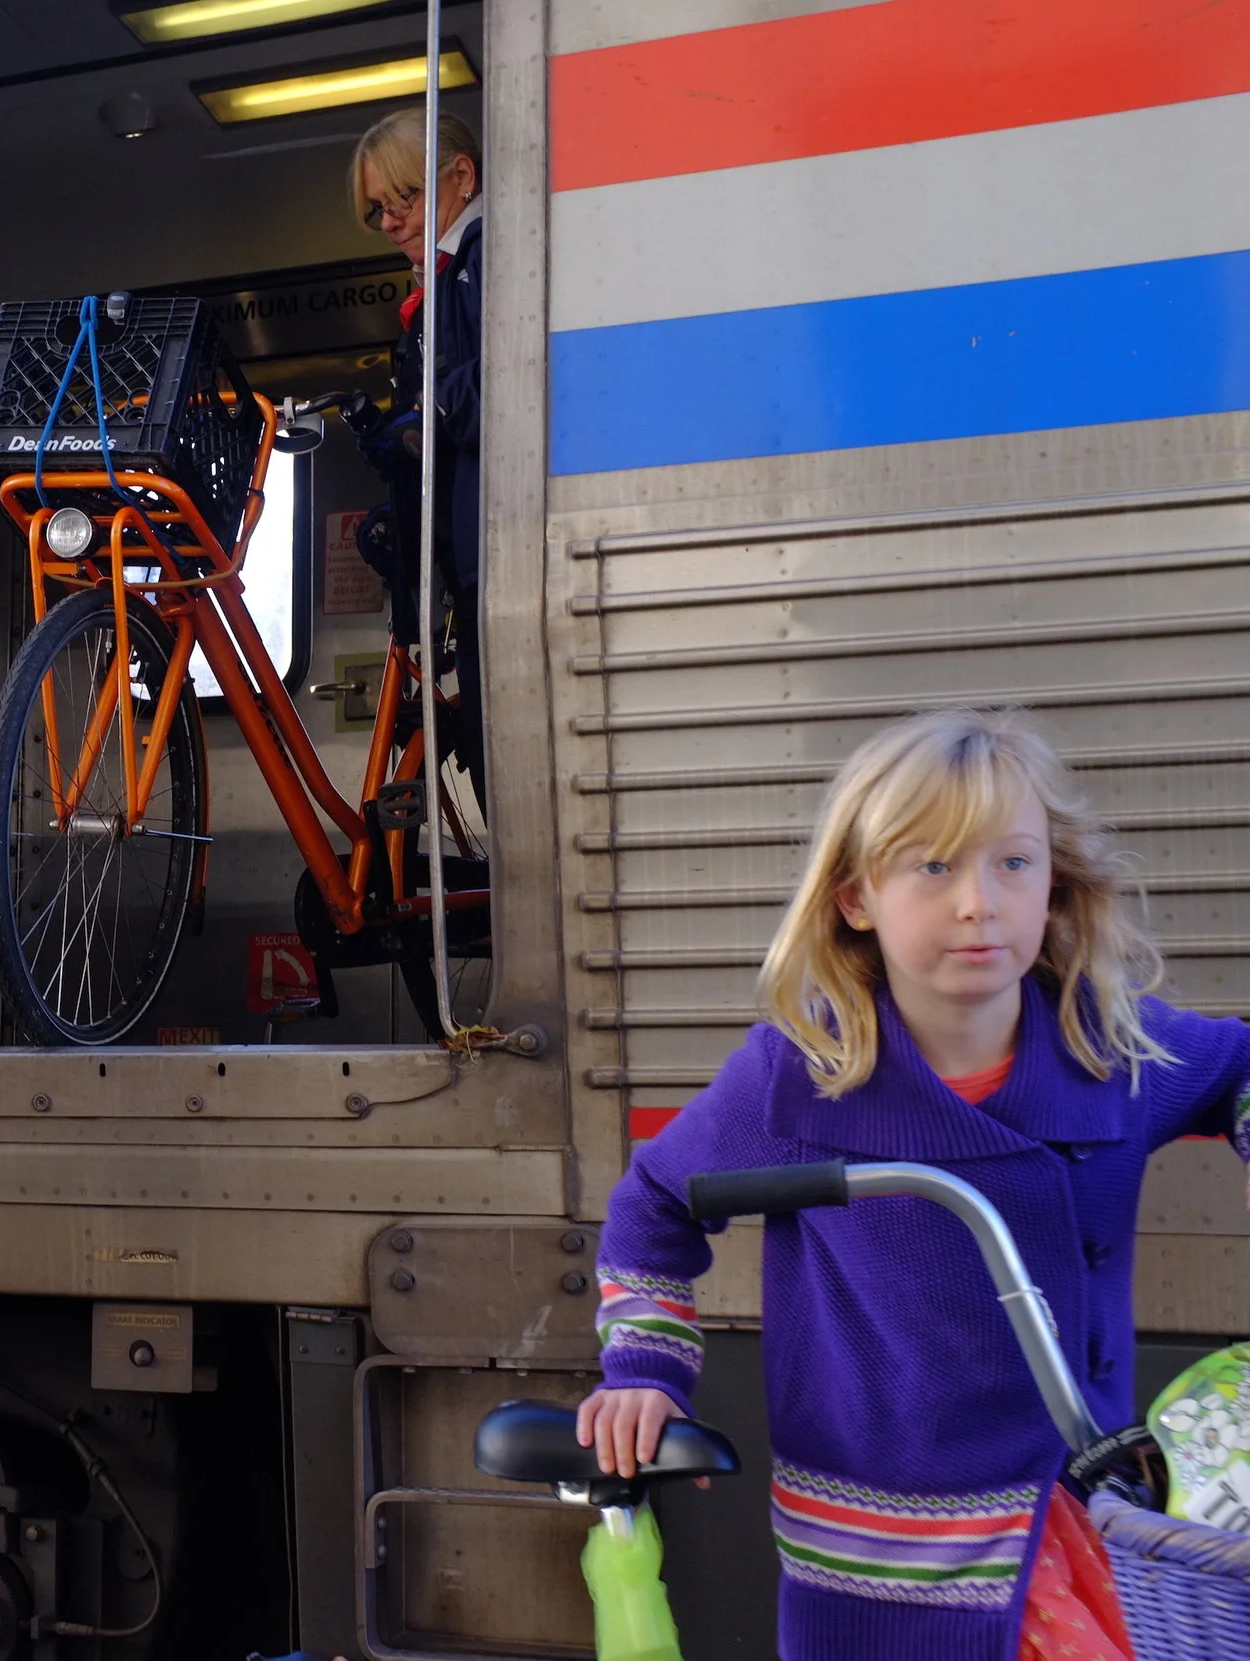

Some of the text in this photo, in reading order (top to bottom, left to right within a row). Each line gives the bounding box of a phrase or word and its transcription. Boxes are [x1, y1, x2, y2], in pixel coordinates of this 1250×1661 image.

[217, 293, 298, 324] XIMUM
[307, 282, 398, 312] CARGO
[254, 935, 302, 946] SECURED
[179, 1027, 218, 1044] EXIT
[135, 1316, 178, 1326] INDICATOR
